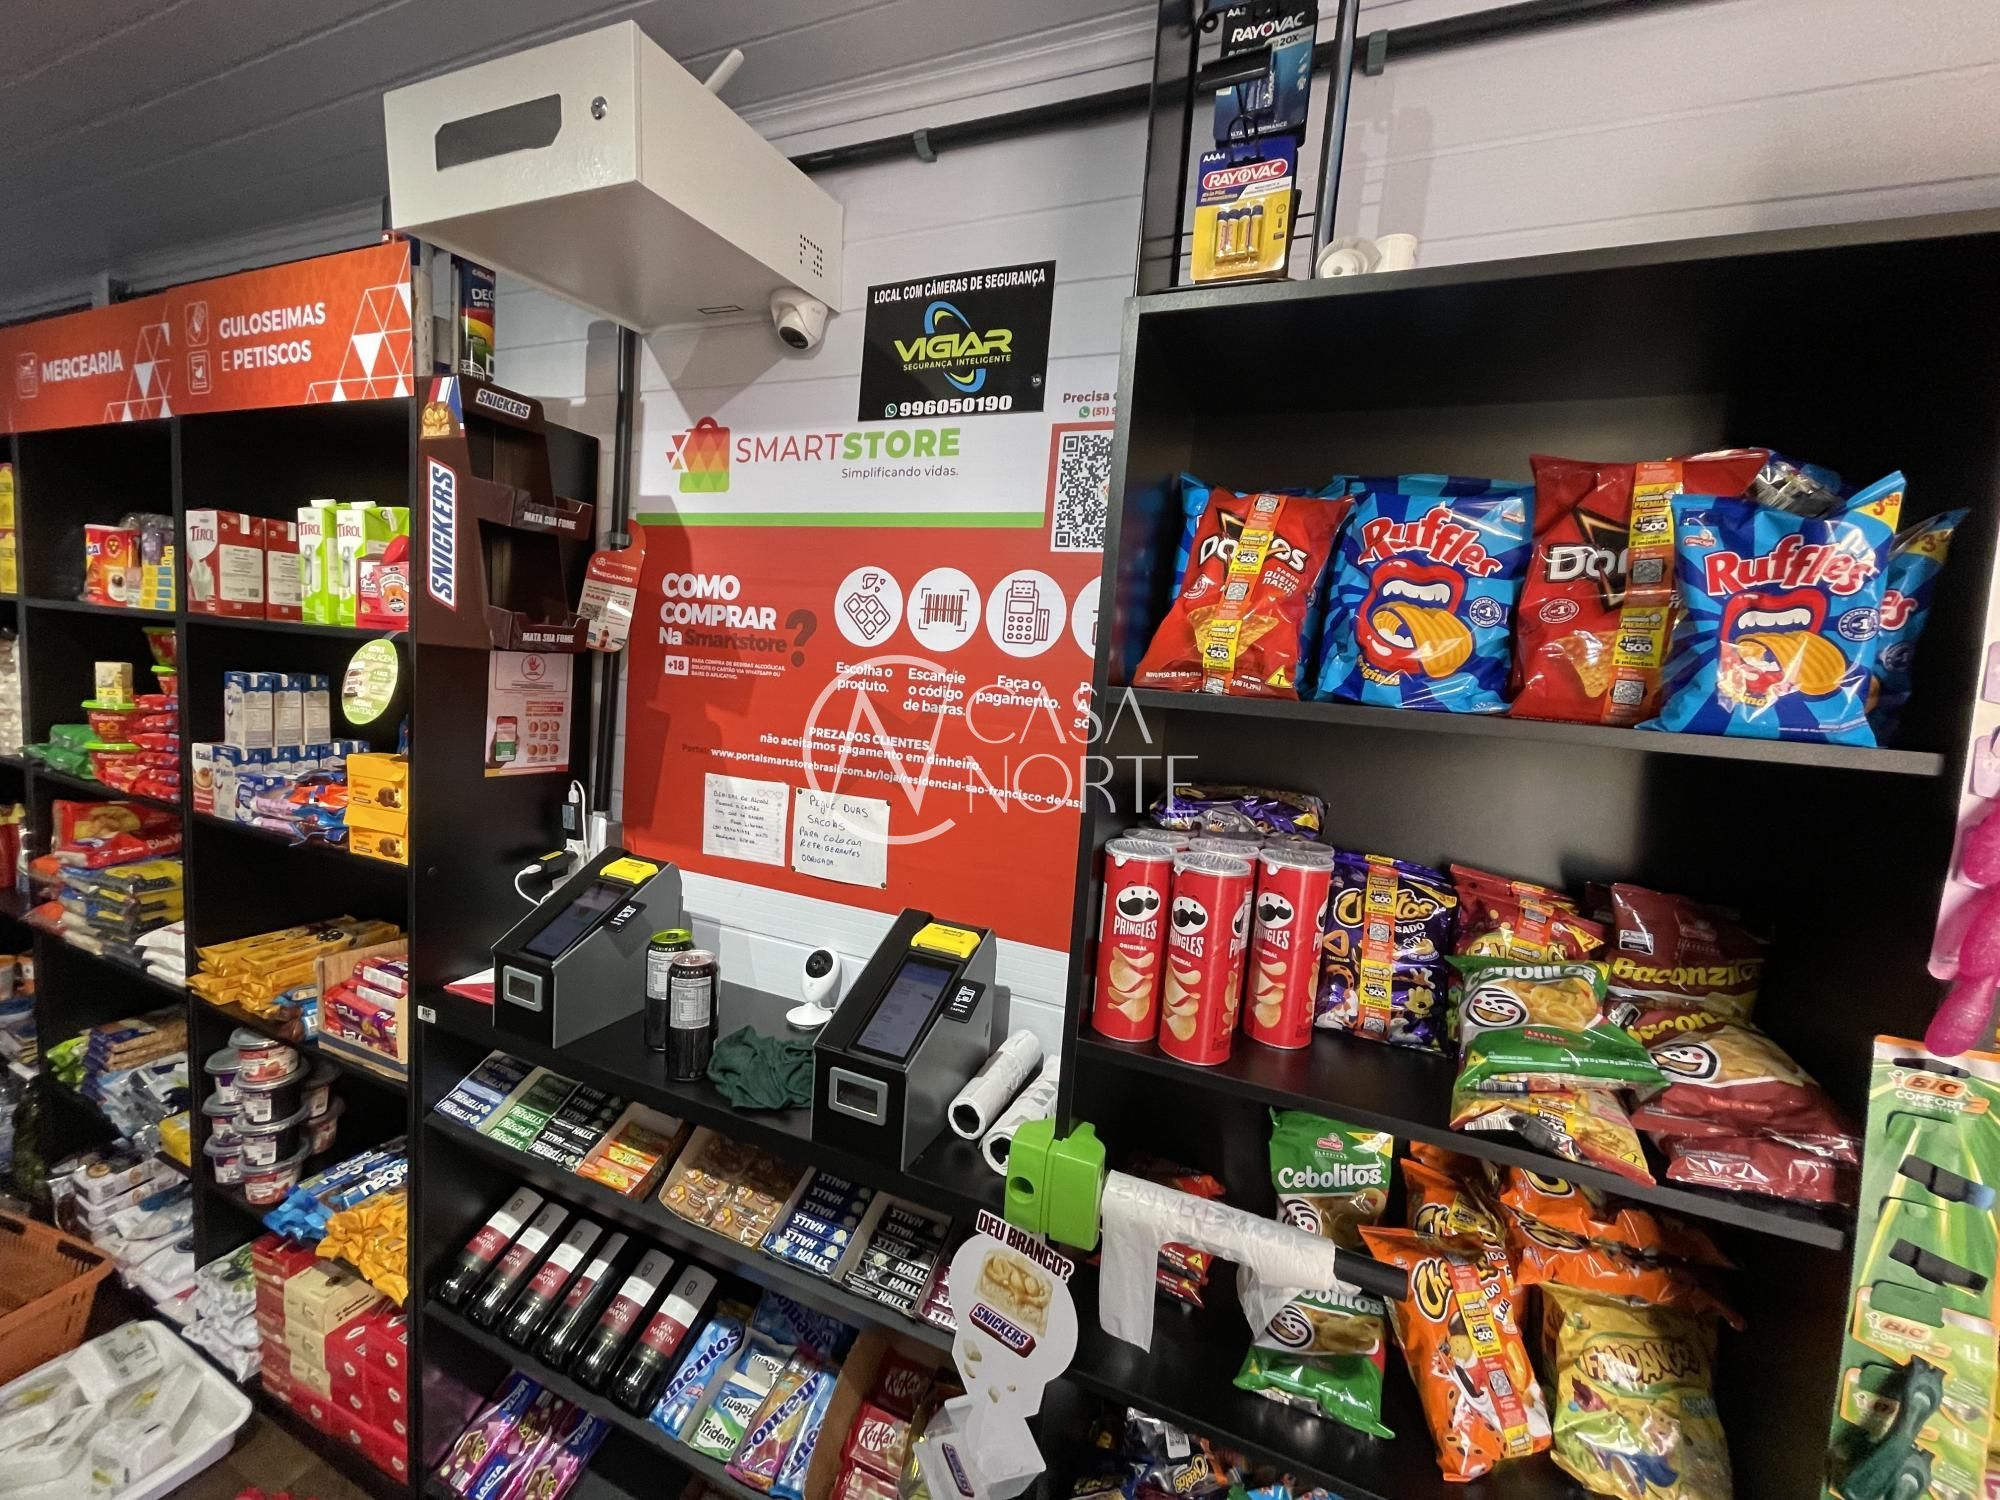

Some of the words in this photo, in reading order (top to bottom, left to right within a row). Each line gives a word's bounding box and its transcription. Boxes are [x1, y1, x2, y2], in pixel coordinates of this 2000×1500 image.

[1231, 11, 1305, 43] RAYOVAC
[1202, 151, 1226, 163] AAA4
[1207, 160, 1283, 188] RAYOVAC
[874, 286, 902, 304] LOCAL
[903, 282, 923, 300] COM
[924, 276, 968, 297] CÂMERAS
[970, 275, 983, 291] DE
[985, 267, 1046, 289] SEGURANÇA
[219, 302, 326, 339] GULOSEIMAS
[221, 350, 231, 371] E
[233, 339, 312, 370] PETISCOS
[893, 328, 1013, 363] VIGIAR
[42, 349, 124, 383] MERCEARIA
[903, 359, 952, 372] SEGURANÇA
[956, 354, 1011, 367] INTELIGENTE
[477, 389, 531, 419] SNICKERS
[900, 395, 1013, 417] 996050190
[1063, 390, 1110, 403] Precisa
[735, 426, 961, 466] SMARTSTORE
[841, 463, 922, 480] Simplificando
[924, 464, 959, 478] vidas.
[524, 511, 543, 526] MATA
[557, 516, 577, 531] FOME
[1640, 521, 1668, 533] 500
[431, 465, 455, 602] SNICKERS
[1357, 502, 1503, 577] Ruffles
[1704, 533, 1878, 598] Ruffles
[661, 572, 741, 600] COMO
[1264, 570, 1298, 592] QUEIJO
[660, 601, 777, 631] COMPRAR
[522, 632, 542, 644] MATA
[557, 633, 574, 644] FOME
[659, 626, 683, 646] Na
[685, 629, 787, 654] Smartstore
[1625, 641, 1653, 652] 500
[1210, 649, 1229, 659] 500
[667, 658, 686, 672] +18
[836, 661, 882, 677] Escolha
[884, 668, 893, 678] o
[837, 678, 889, 693] produto.
[908, 667, 966, 684] Escaneie
[997, 674, 1028, 692] Faça
[1032, 680, 1042, 691] o
[908, 685, 917, 696] o
[918, 685, 964, 702] código
[975, 691, 1061, 710] pagamento.
[902, 700, 920, 713] de
[921, 702, 966, 717] barras.
[809, 726, 871, 744] PREZADOS
[872, 731, 933, 752] CLIENTES,
[760, 733, 780, 745] não
[781, 736, 836, 753] aceitamos
[838, 742, 903, 761] pagamento
[905, 752, 925, 765] em
[926, 751, 982, 771] dinheiro.
[1113, 915, 1158, 940] PRINGLES
[1119, 942, 1147, 951] ORIGINAL
[1911, 1076, 1960, 1095] BIC
[1895, 1090, 1967, 1111] COMFORT
[509, 1104, 544, 1125] FREEGELLS
[541, 1130, 566, 1145] HALLS
[572, 1126, 598, 1141] HALLS
[528, 1139, 567, 1163] FREEGELLS
[818, 1172, 851, 1192] HALLS
[1278, 1162, 1383, 1189] Cebolitos
[811, 1186, 845, 1206] HALLS
[803, 1201, 837, 1220] HALLS
[792, 1213, 827, 1234] HALLS
[475, 1236, 497, 1253] MARTIN
[482, 1231, 497, 1243] SAN
[783, 1228, 818, 1250] HALLS
[977, 1212, 1008, 1242] DEU
[1005, 1227, 1074, 1283] BRANCO?
[794, 1248, 832, 1272] HALLS
[615, 1301, 629, 1313] SAN
[877, 1290, 911, 1310] HALLS
[606, 1306, 630, 1324] MARTIN
[649, 1326, 675, 1346] MARTIN
[660, 1321, 675, 1333] SAN
[973, 1305, 1030, 1348] SNICKERS
[1883, 1319, 1926, 1338] BIC
[661, 1325, 743, 1407] mentos
[699, 1417, 737, 1450] Trident
[860, 1422, 896, 1451] KitKat
